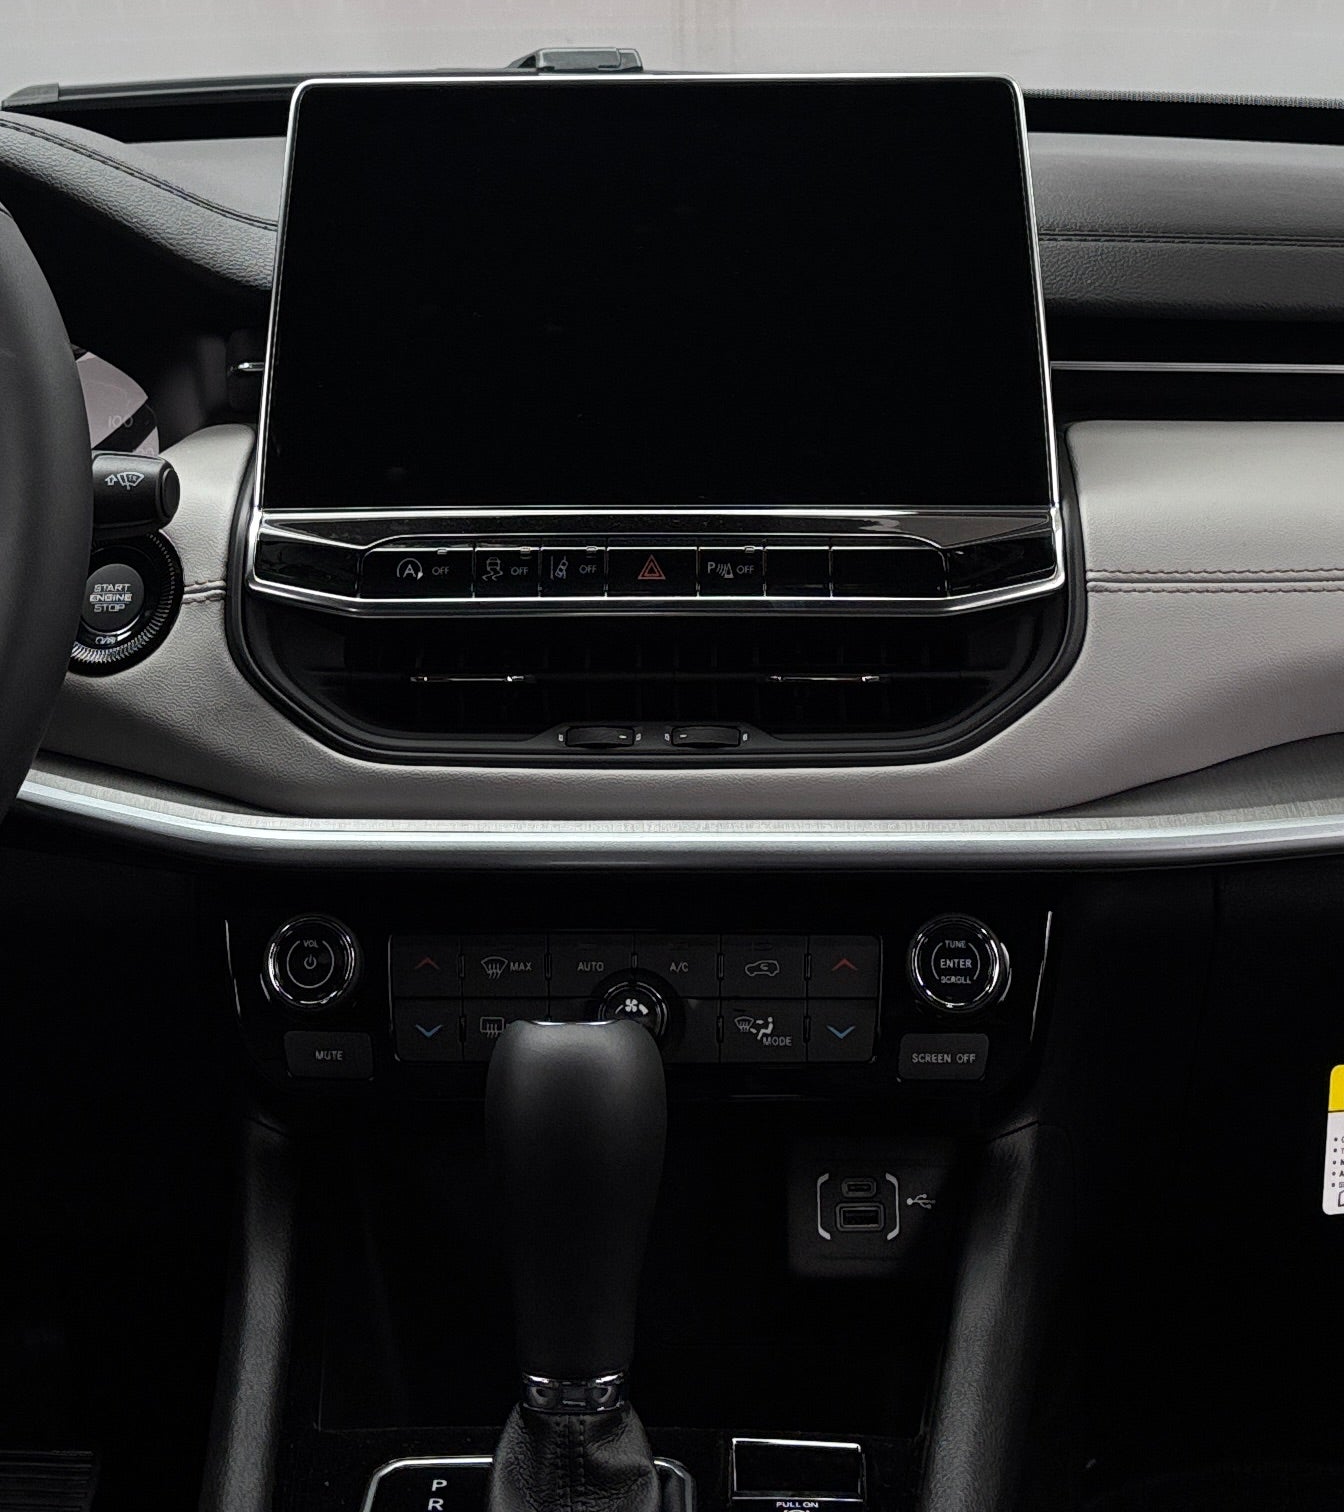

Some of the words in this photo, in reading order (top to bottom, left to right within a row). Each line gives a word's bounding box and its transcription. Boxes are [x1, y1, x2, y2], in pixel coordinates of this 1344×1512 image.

[432, 566, 450, 575] OFF
[511, 566, 528, 575] OFF
[580, 564, 598, 574] OFF
[736, 565, 755, 575] OFF
[93, 583, 131, 593] START
[89, 592, 132, 602] ENGINE
[93, 603, 126, 613] STOP
[303, 940, 318, 949] VOL
[945, 940, 967, 949] TUNE
[510, 961, 533, 971] MAX
[577, 962, 604, 971] AUTO
[670, 963, 689, 973] A/C
[940, 959, 972, 969] ENTER
[940, 975, 972, 984] SCROLL
[763, 1036, 793, 1046] MODE
[315, 1050, 343, 1060] MUTE
[912, 1053, 951, 1063] SCREEN
[956, 1053, 976, 1063] OFF
[431, 1479, 447, 1492] P
[428, 1498, 444, 1512] R
[801, 1501, 819, 1509] ON
